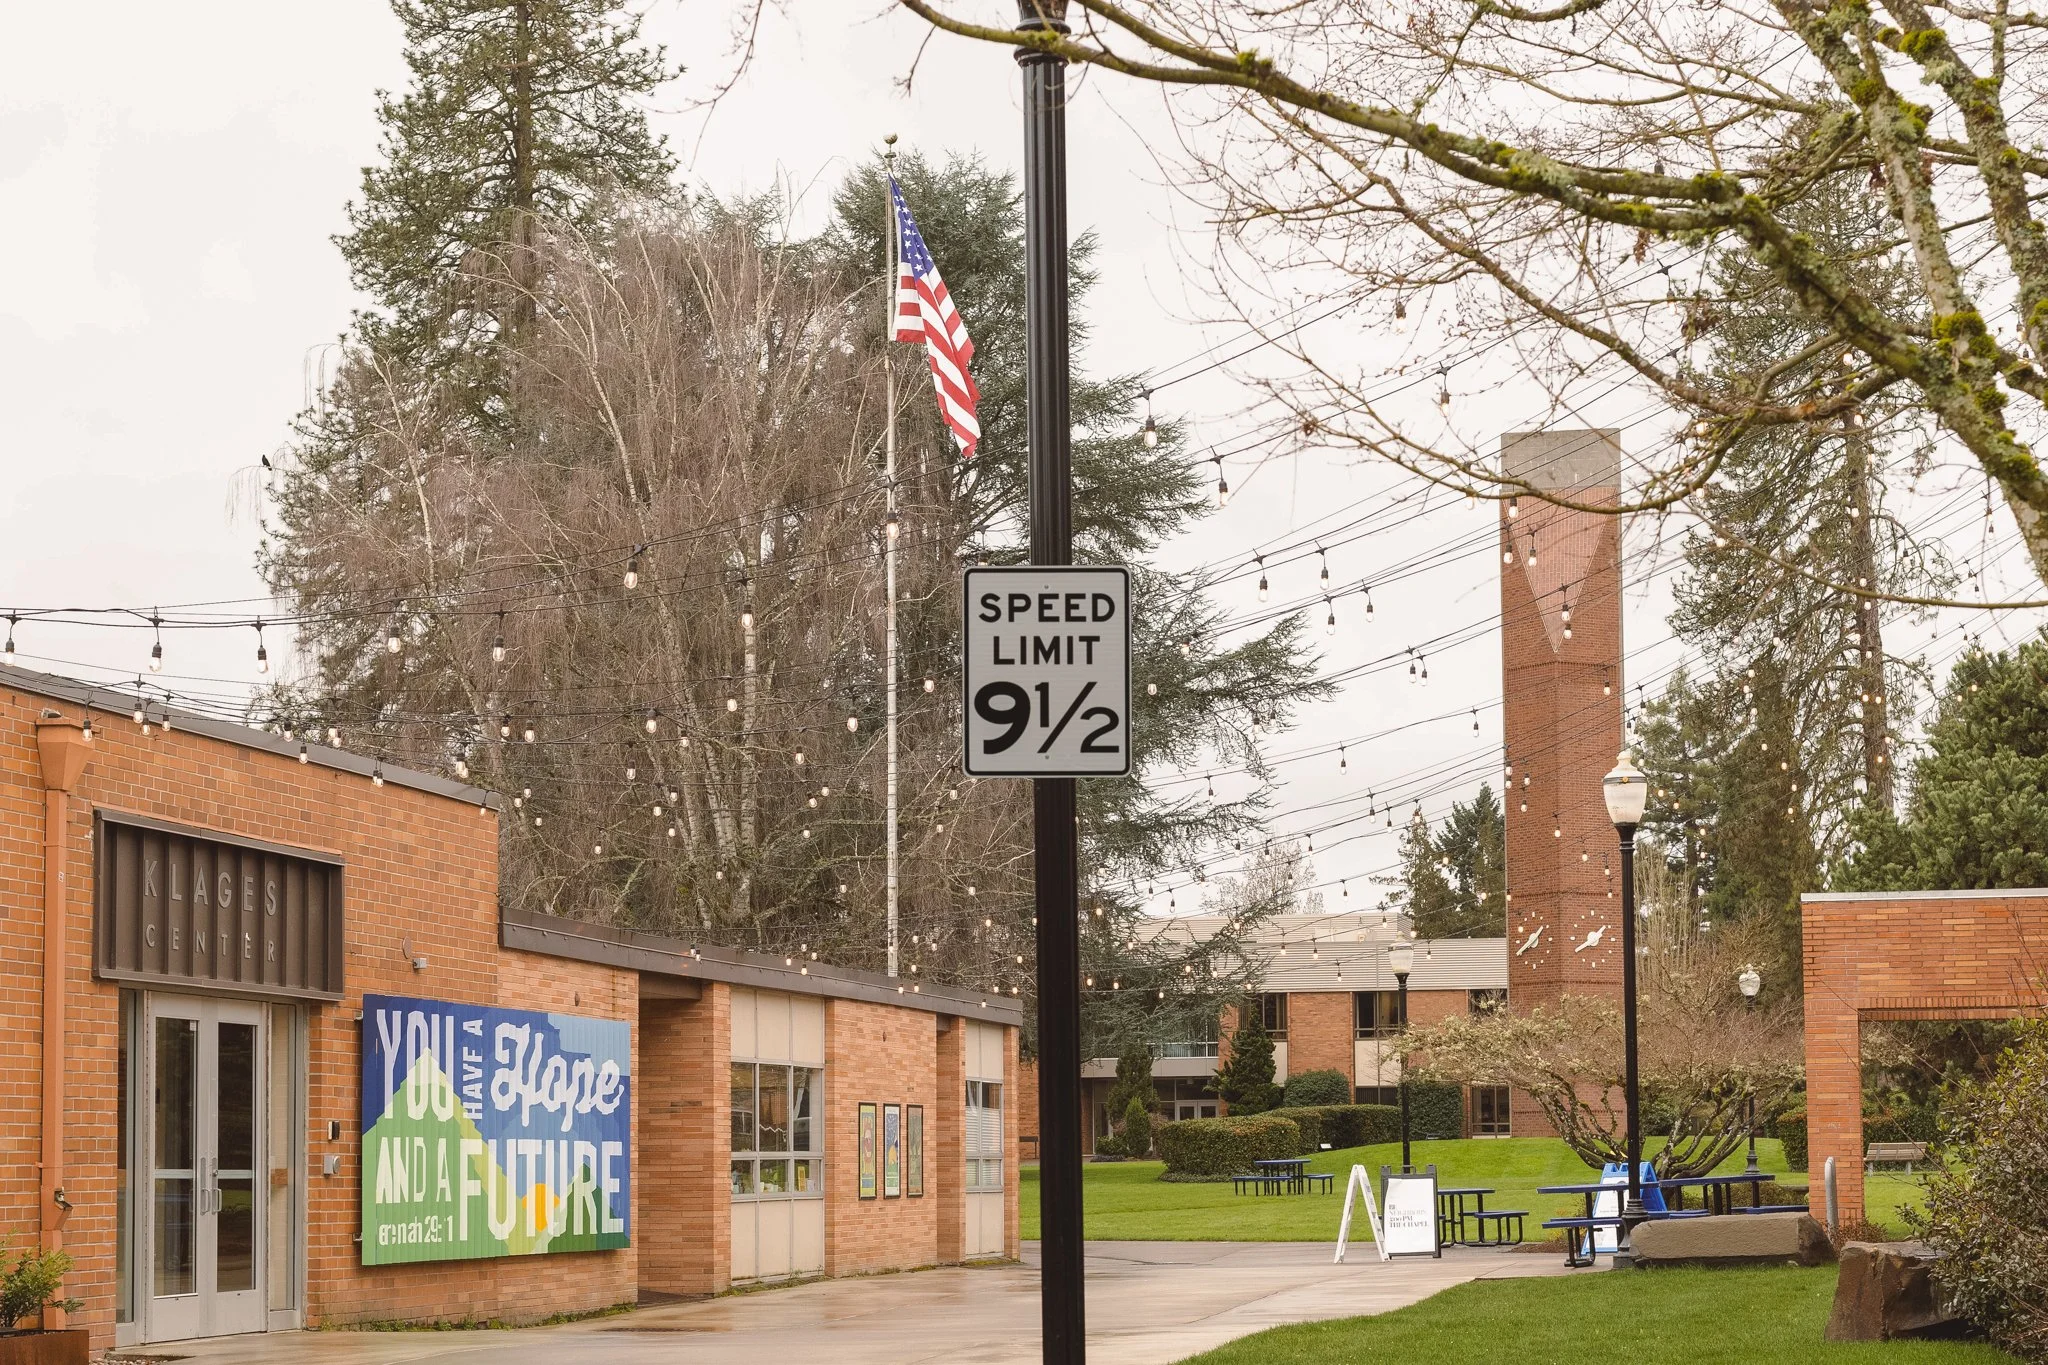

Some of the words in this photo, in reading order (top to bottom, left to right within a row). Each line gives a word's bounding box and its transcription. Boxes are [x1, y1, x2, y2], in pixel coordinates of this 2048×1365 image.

[979, 593, 1115, 622] SPEED
[993, 635, 1100, 665] LIMIT
[144, 859, 277, 916] KLAGES
[145, 924, 275, 962] CENTER
[462, 1019, 483, 1036] A
[376, 1009, 454, 1122] YOU
[462, 1046, 483, 1120] HAVE
[490, 1022, 625, 1132] Hope
[375, 1136, 427, 1204] AND
[435, 1137, 452, 1203] A
[459, 1138, 624, 1241] FUTURE
